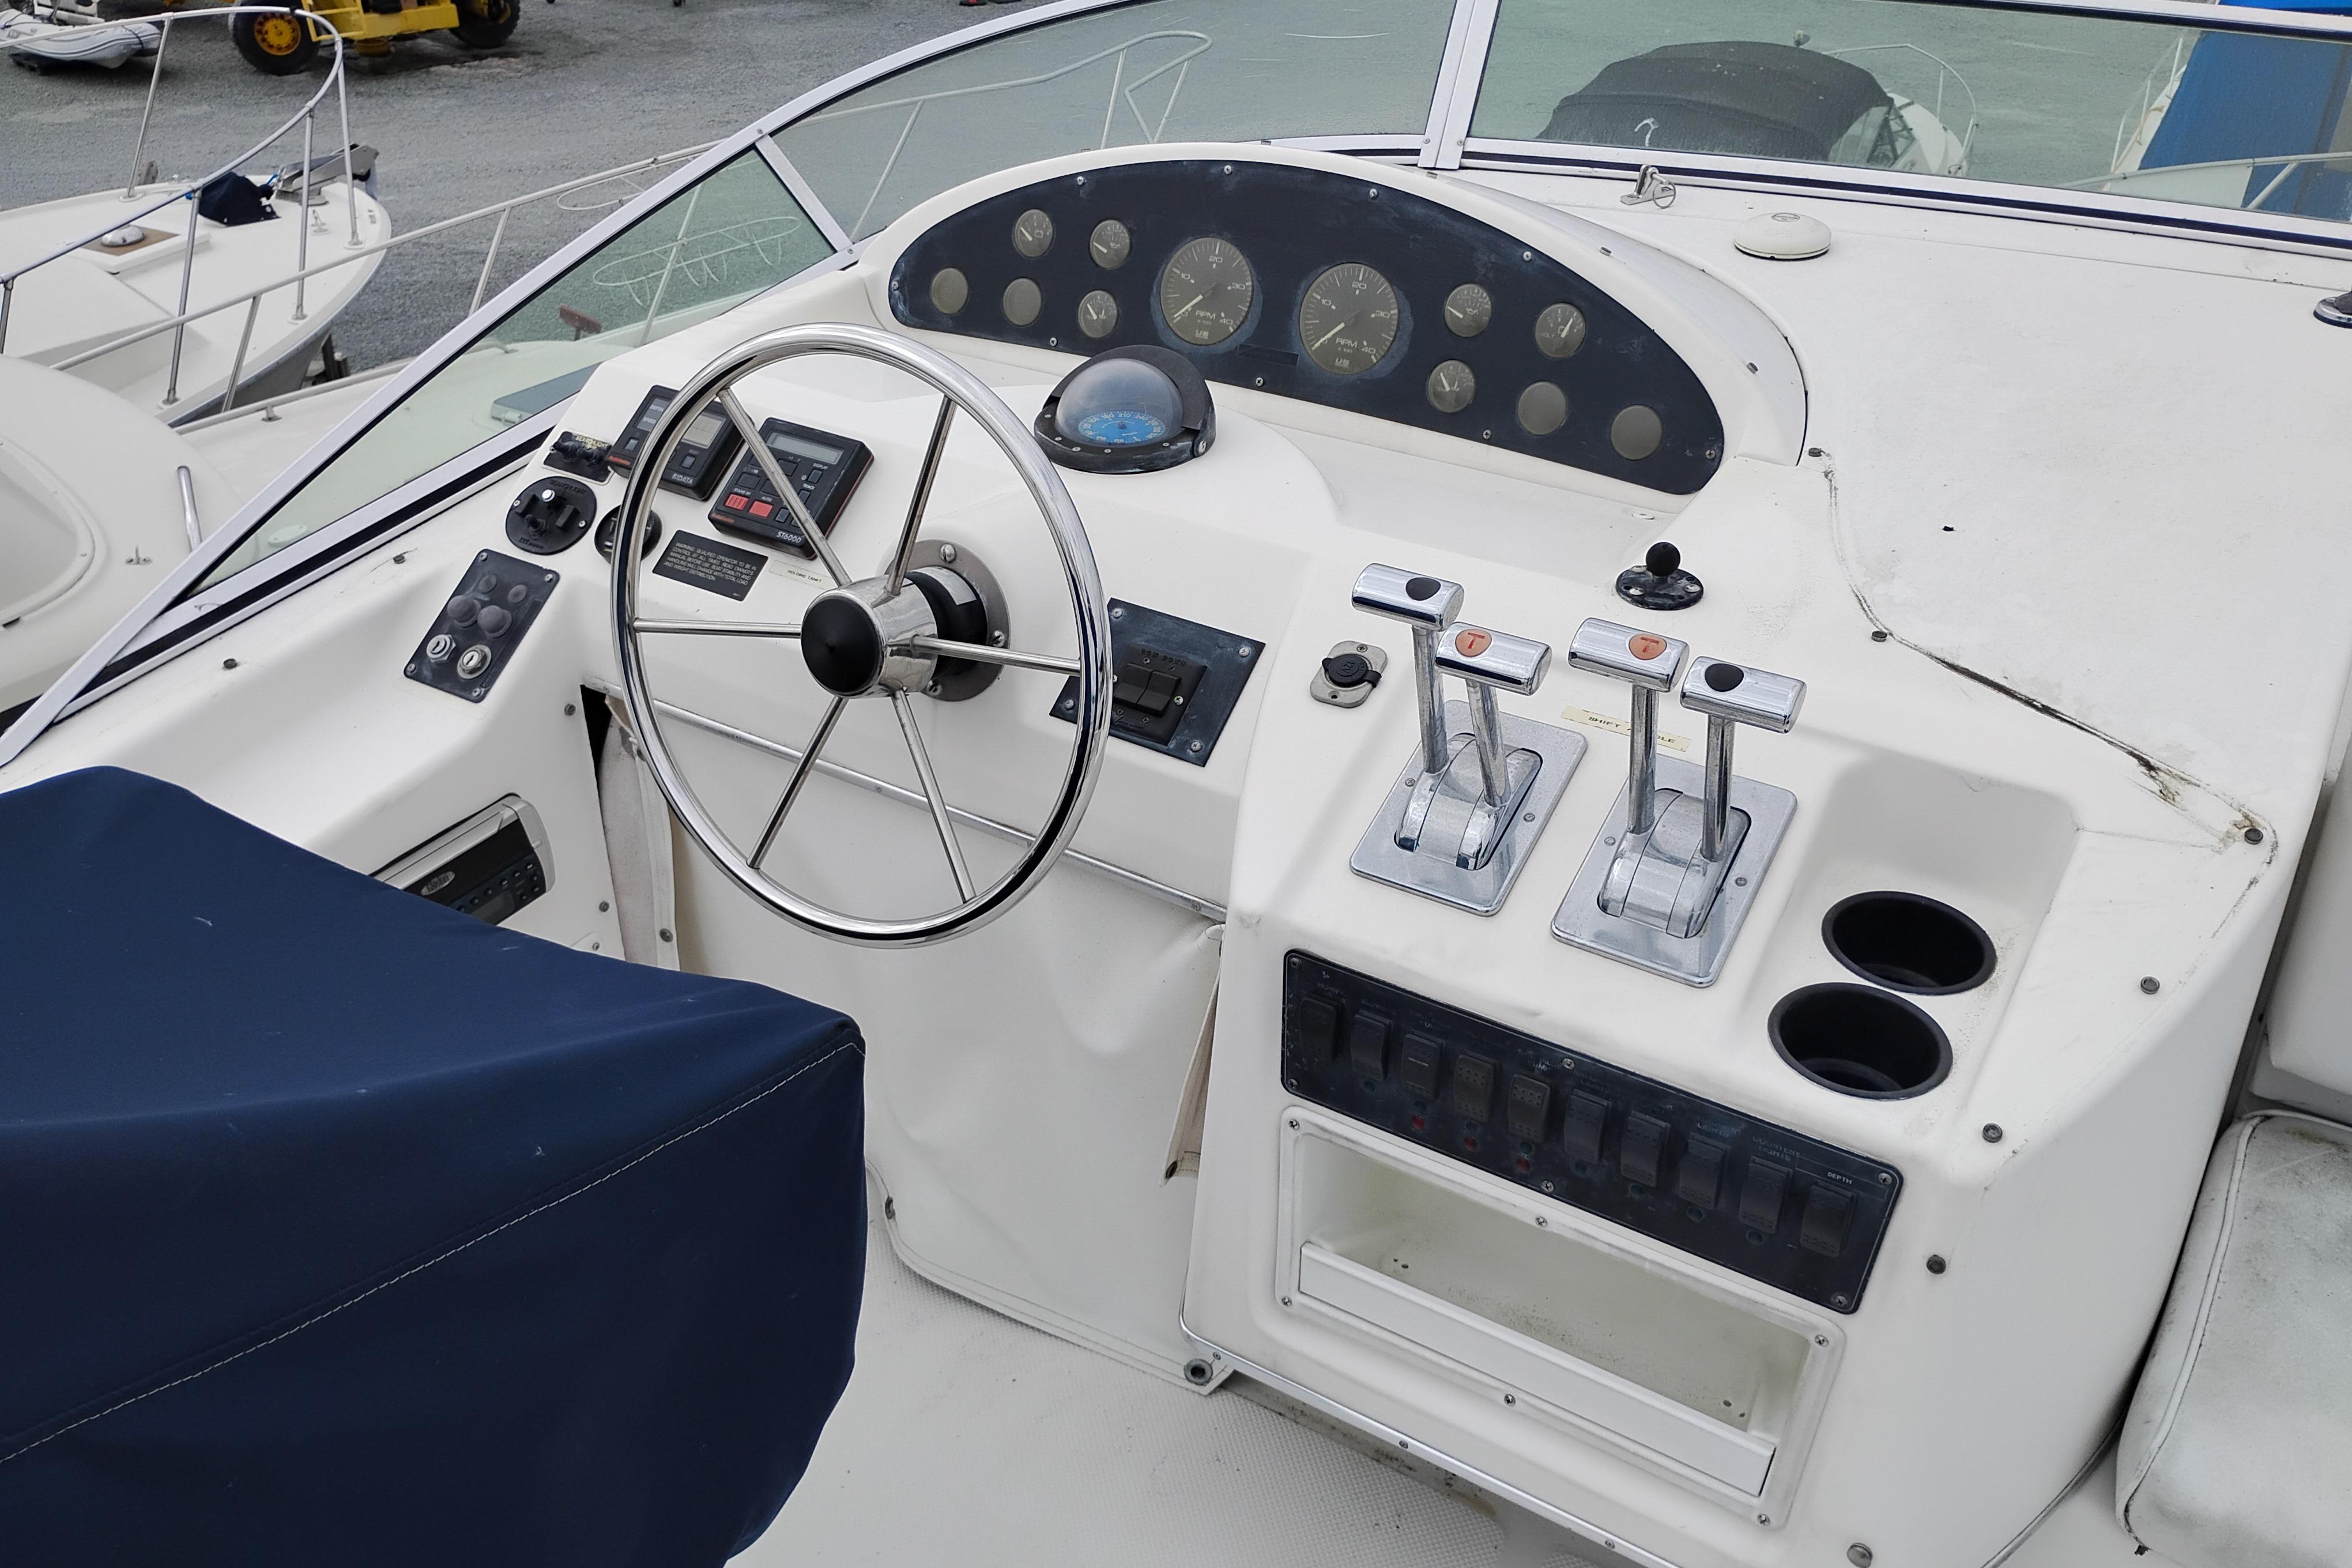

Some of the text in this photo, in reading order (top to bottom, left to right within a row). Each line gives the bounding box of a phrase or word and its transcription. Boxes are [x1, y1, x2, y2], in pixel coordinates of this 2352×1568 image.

[1195, 310, 1216, 320] RPM
[1375, 310, 1390, 318] 30
[1336, 337, 1358, 348] RPM
[1361, 346, 1376, 355] 40
[672, 473, 693, 484] BIDATA
[777, 531, 802, 543] ST6000
[672, 547, 691, 556] CONTROL
[669, 552, 687, 561] MANUAL
[687, 556, 702, 565] BEFORE
[711, 564, 723, 572] BOAT
[696, 565, 713, 575] CHANGE
[724, 574, 736, 582] TOTAL
[736, 578, 749, 586] LOAD
[1467, 632, 1485, 649] T
[1640, 636, 1660, 653] T
[1588, 716, 1621, 728] SHIFT
[1827, 1171, 1853, 1185] DEPTH
